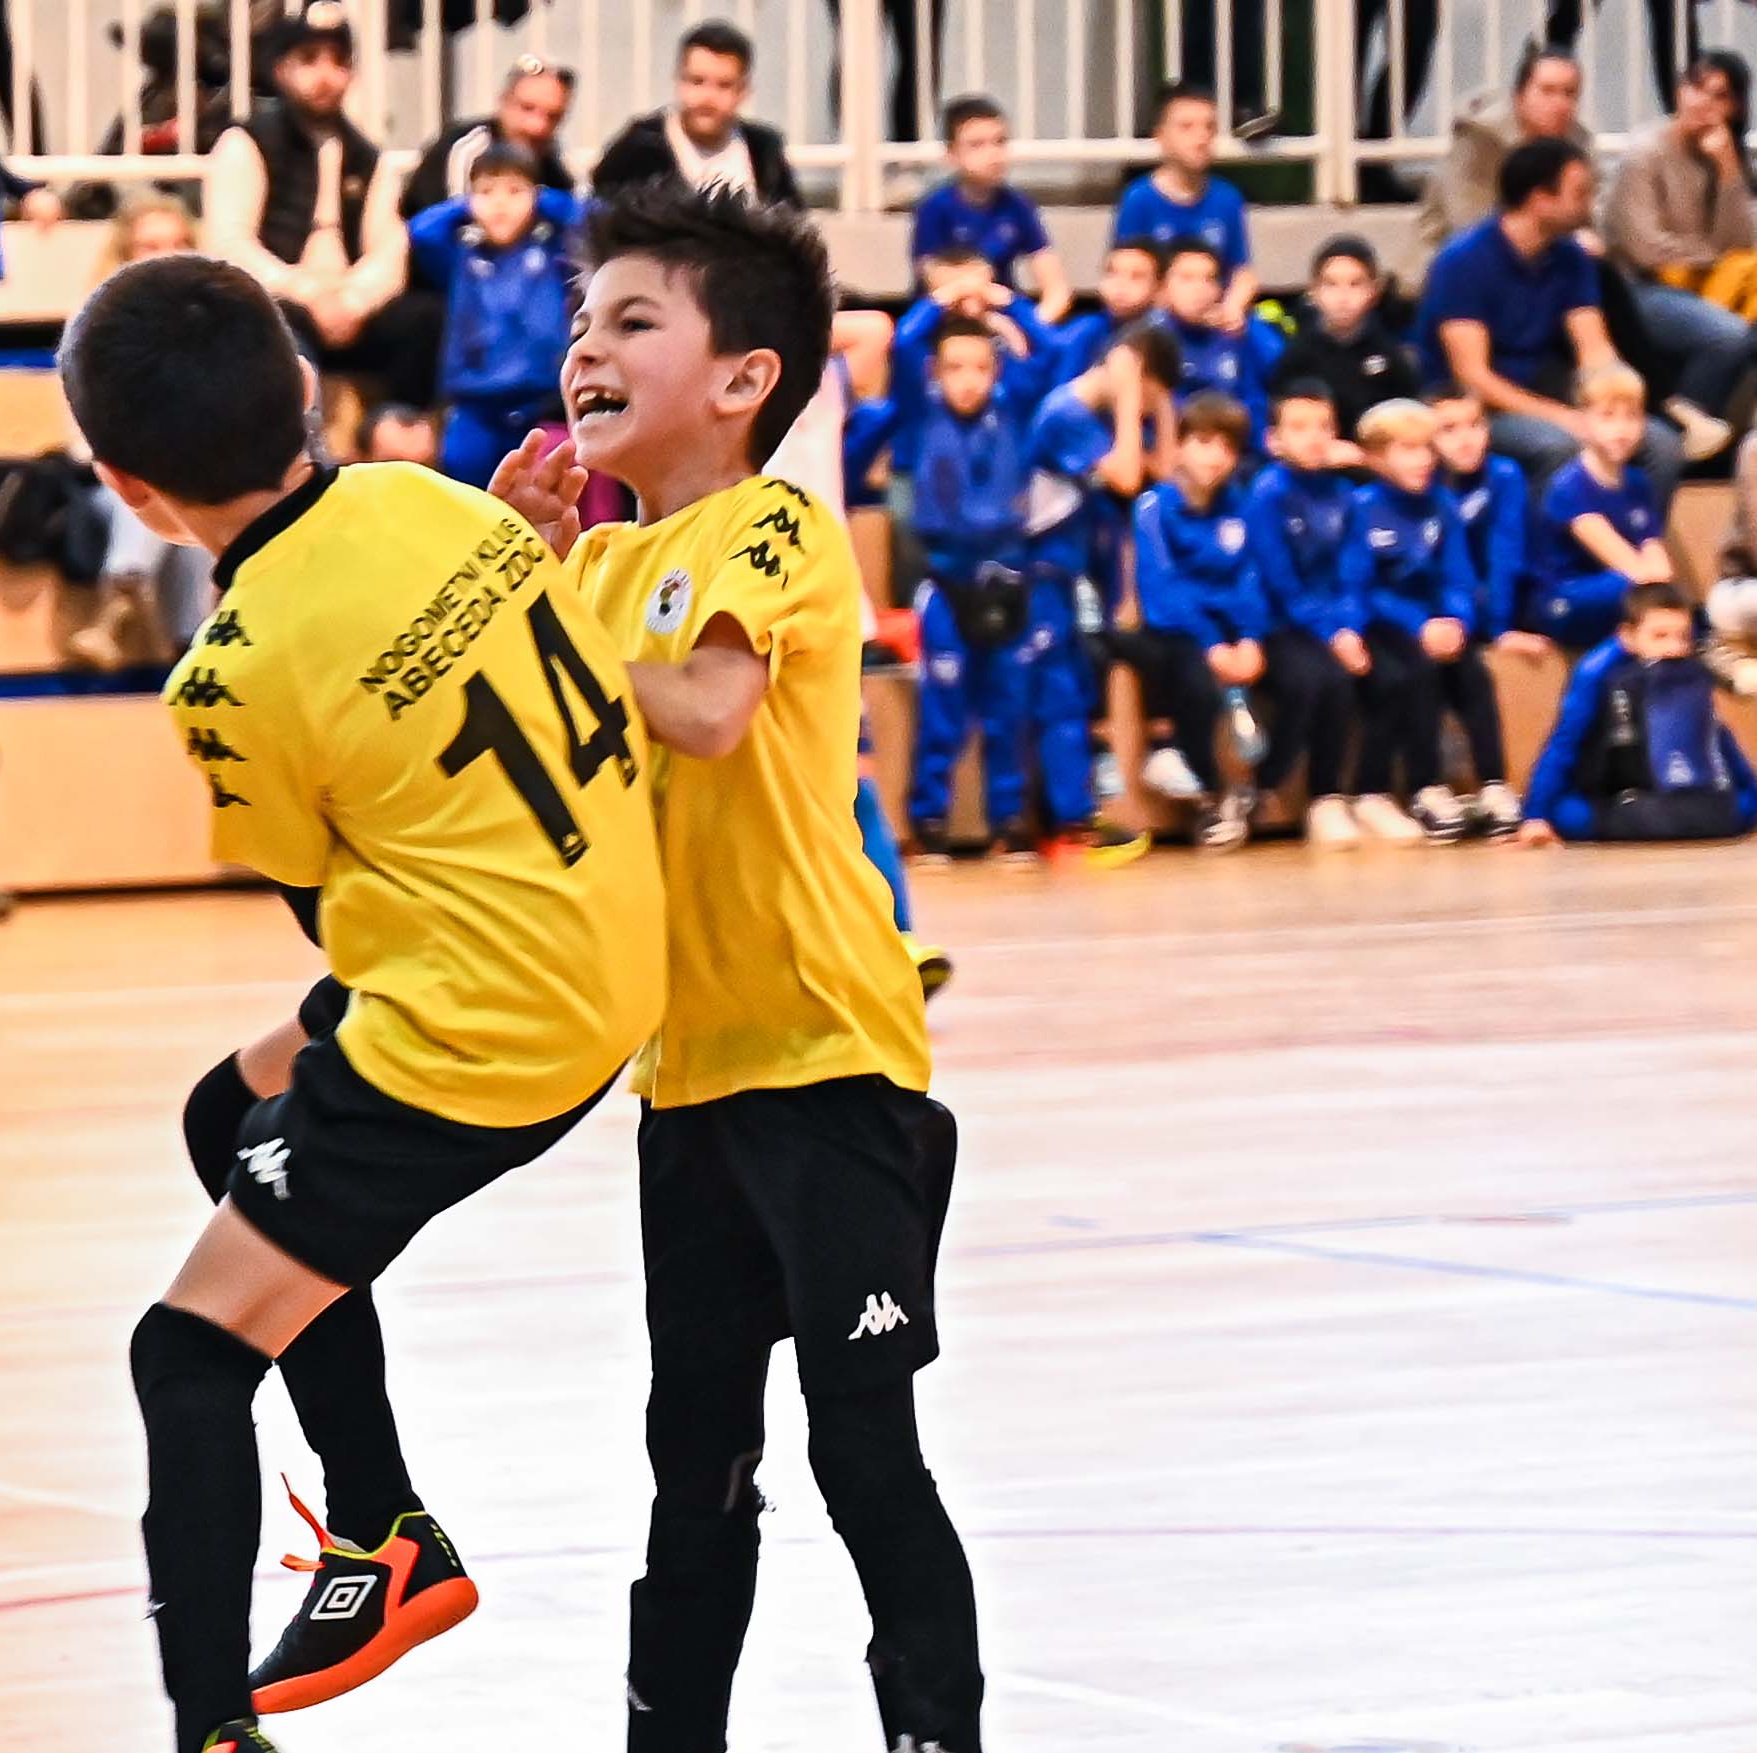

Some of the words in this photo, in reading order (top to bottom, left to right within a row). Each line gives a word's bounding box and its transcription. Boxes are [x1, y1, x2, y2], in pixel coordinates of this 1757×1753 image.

[383, 586, 506, 721] ABECEDA
[495, 536, 546, 592] ZDC
[434, 588, 640, 870] 14
